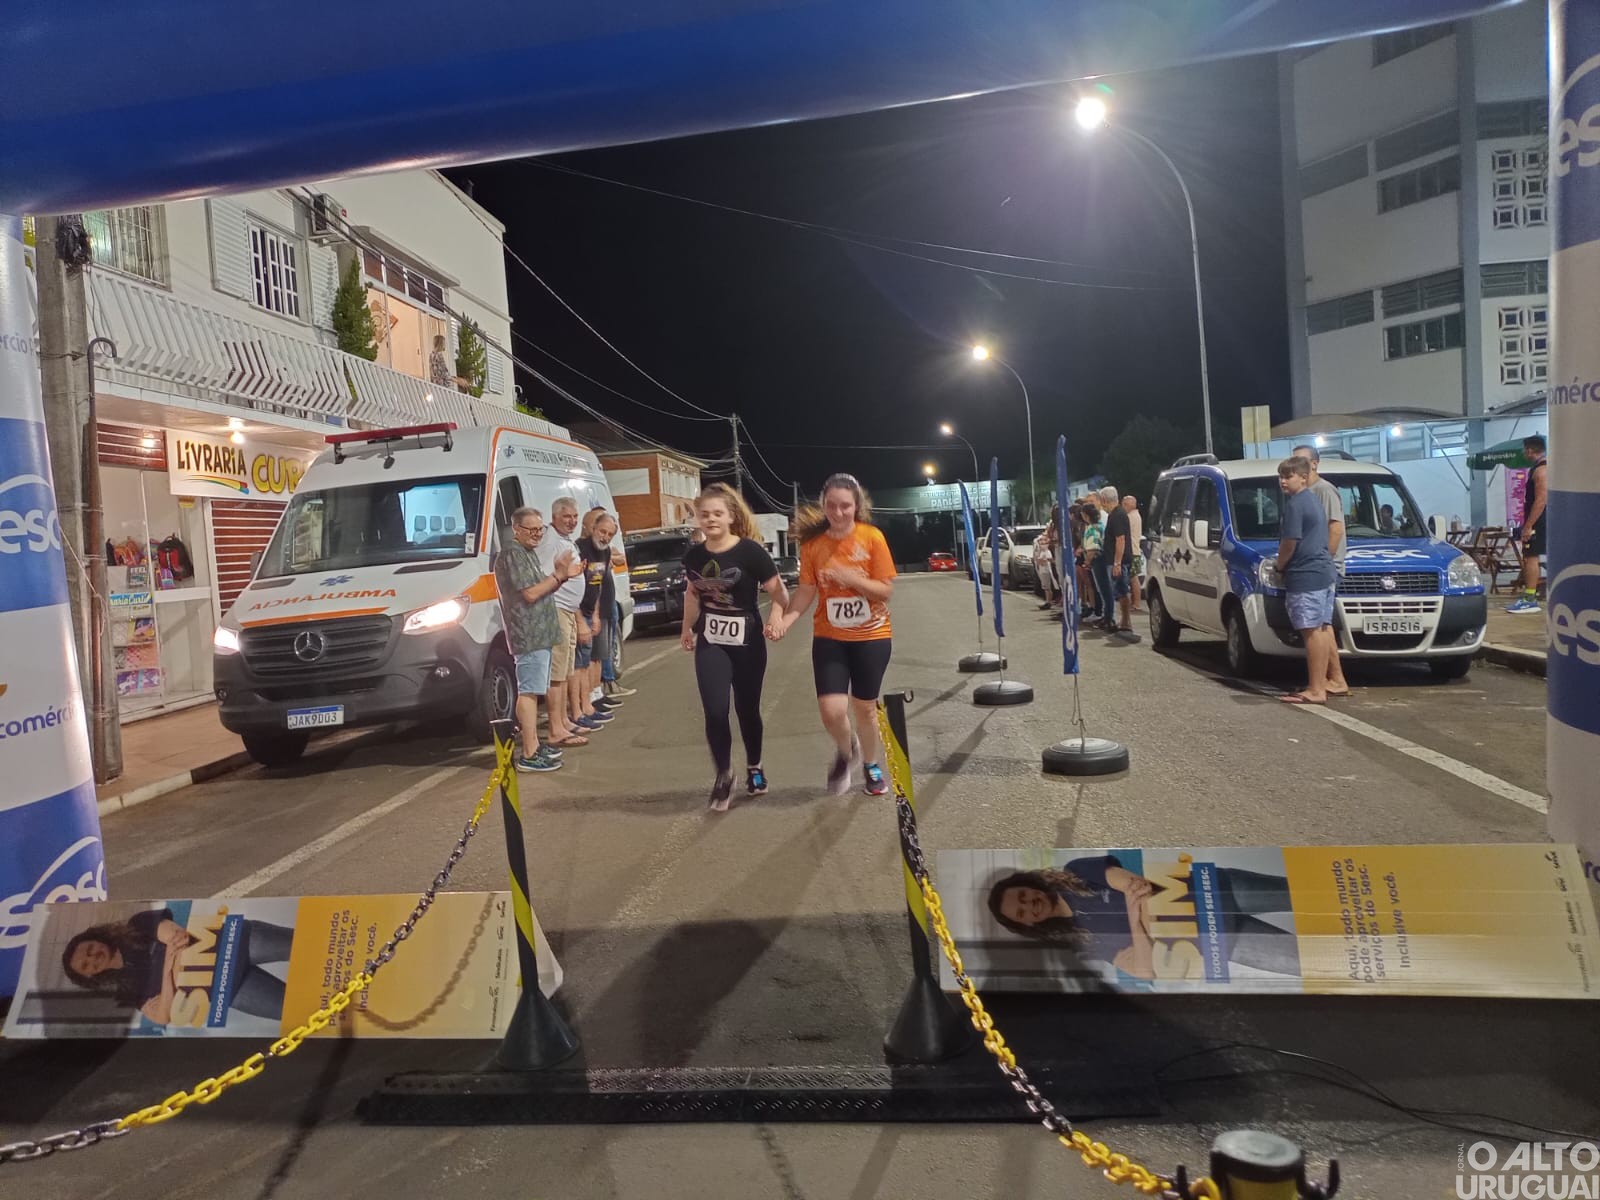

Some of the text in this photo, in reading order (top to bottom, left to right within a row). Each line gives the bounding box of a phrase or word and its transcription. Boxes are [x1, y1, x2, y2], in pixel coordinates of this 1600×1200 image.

[252, 453, 309, 494] CUR
[709, 618, 740, 637] 970
[832, 600, 865, 619] 782
[327, 912, 340, 954] mundo
[347, 915, 359, 946] Sesc.
[366, 922, 377, 954] você.
[1200, 866, 1221, 979] TODOS PODEM SER SESC.
[1331, 860, 1361, 981] Aqui, todo mundo
[1343, 858, 1375, 983] pode aproveitar os
[1358, 863, 1386, 978] serviços do Sesc.
[1383, 871, 1410, 968] Inclusive você.
[214, 918, 238, 1023] TODOS PODEM SER SESC.
[333, 909, 350, 990] aproveitar os
[345, 950, 354, 966] do
[322, 958, 334, 987] todo
